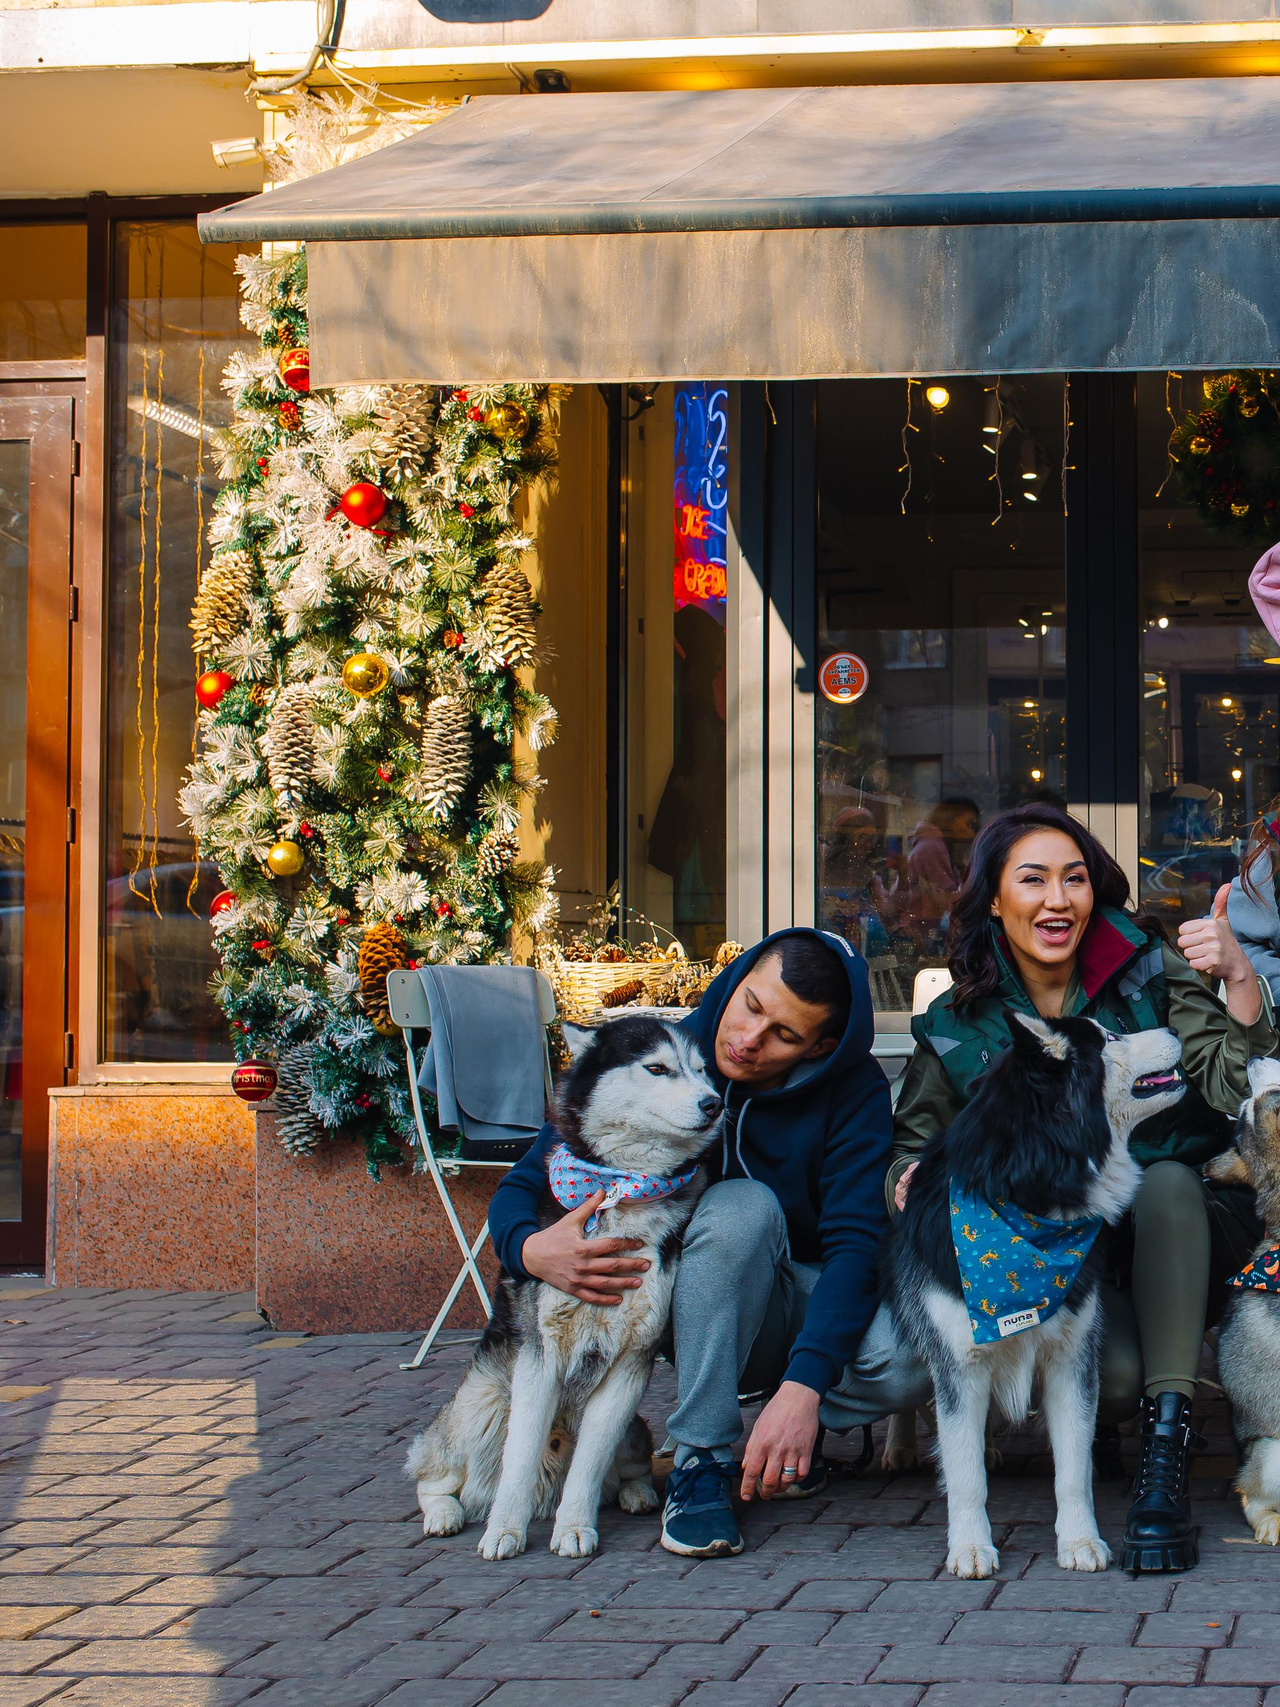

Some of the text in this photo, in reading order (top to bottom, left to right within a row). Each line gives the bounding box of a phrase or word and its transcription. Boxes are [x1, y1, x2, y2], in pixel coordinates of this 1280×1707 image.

[682, 504, 711, 540] ICE
[831, 677, 857, 686] AEMS
[1004, 1313, 1033, 1327] nuna
